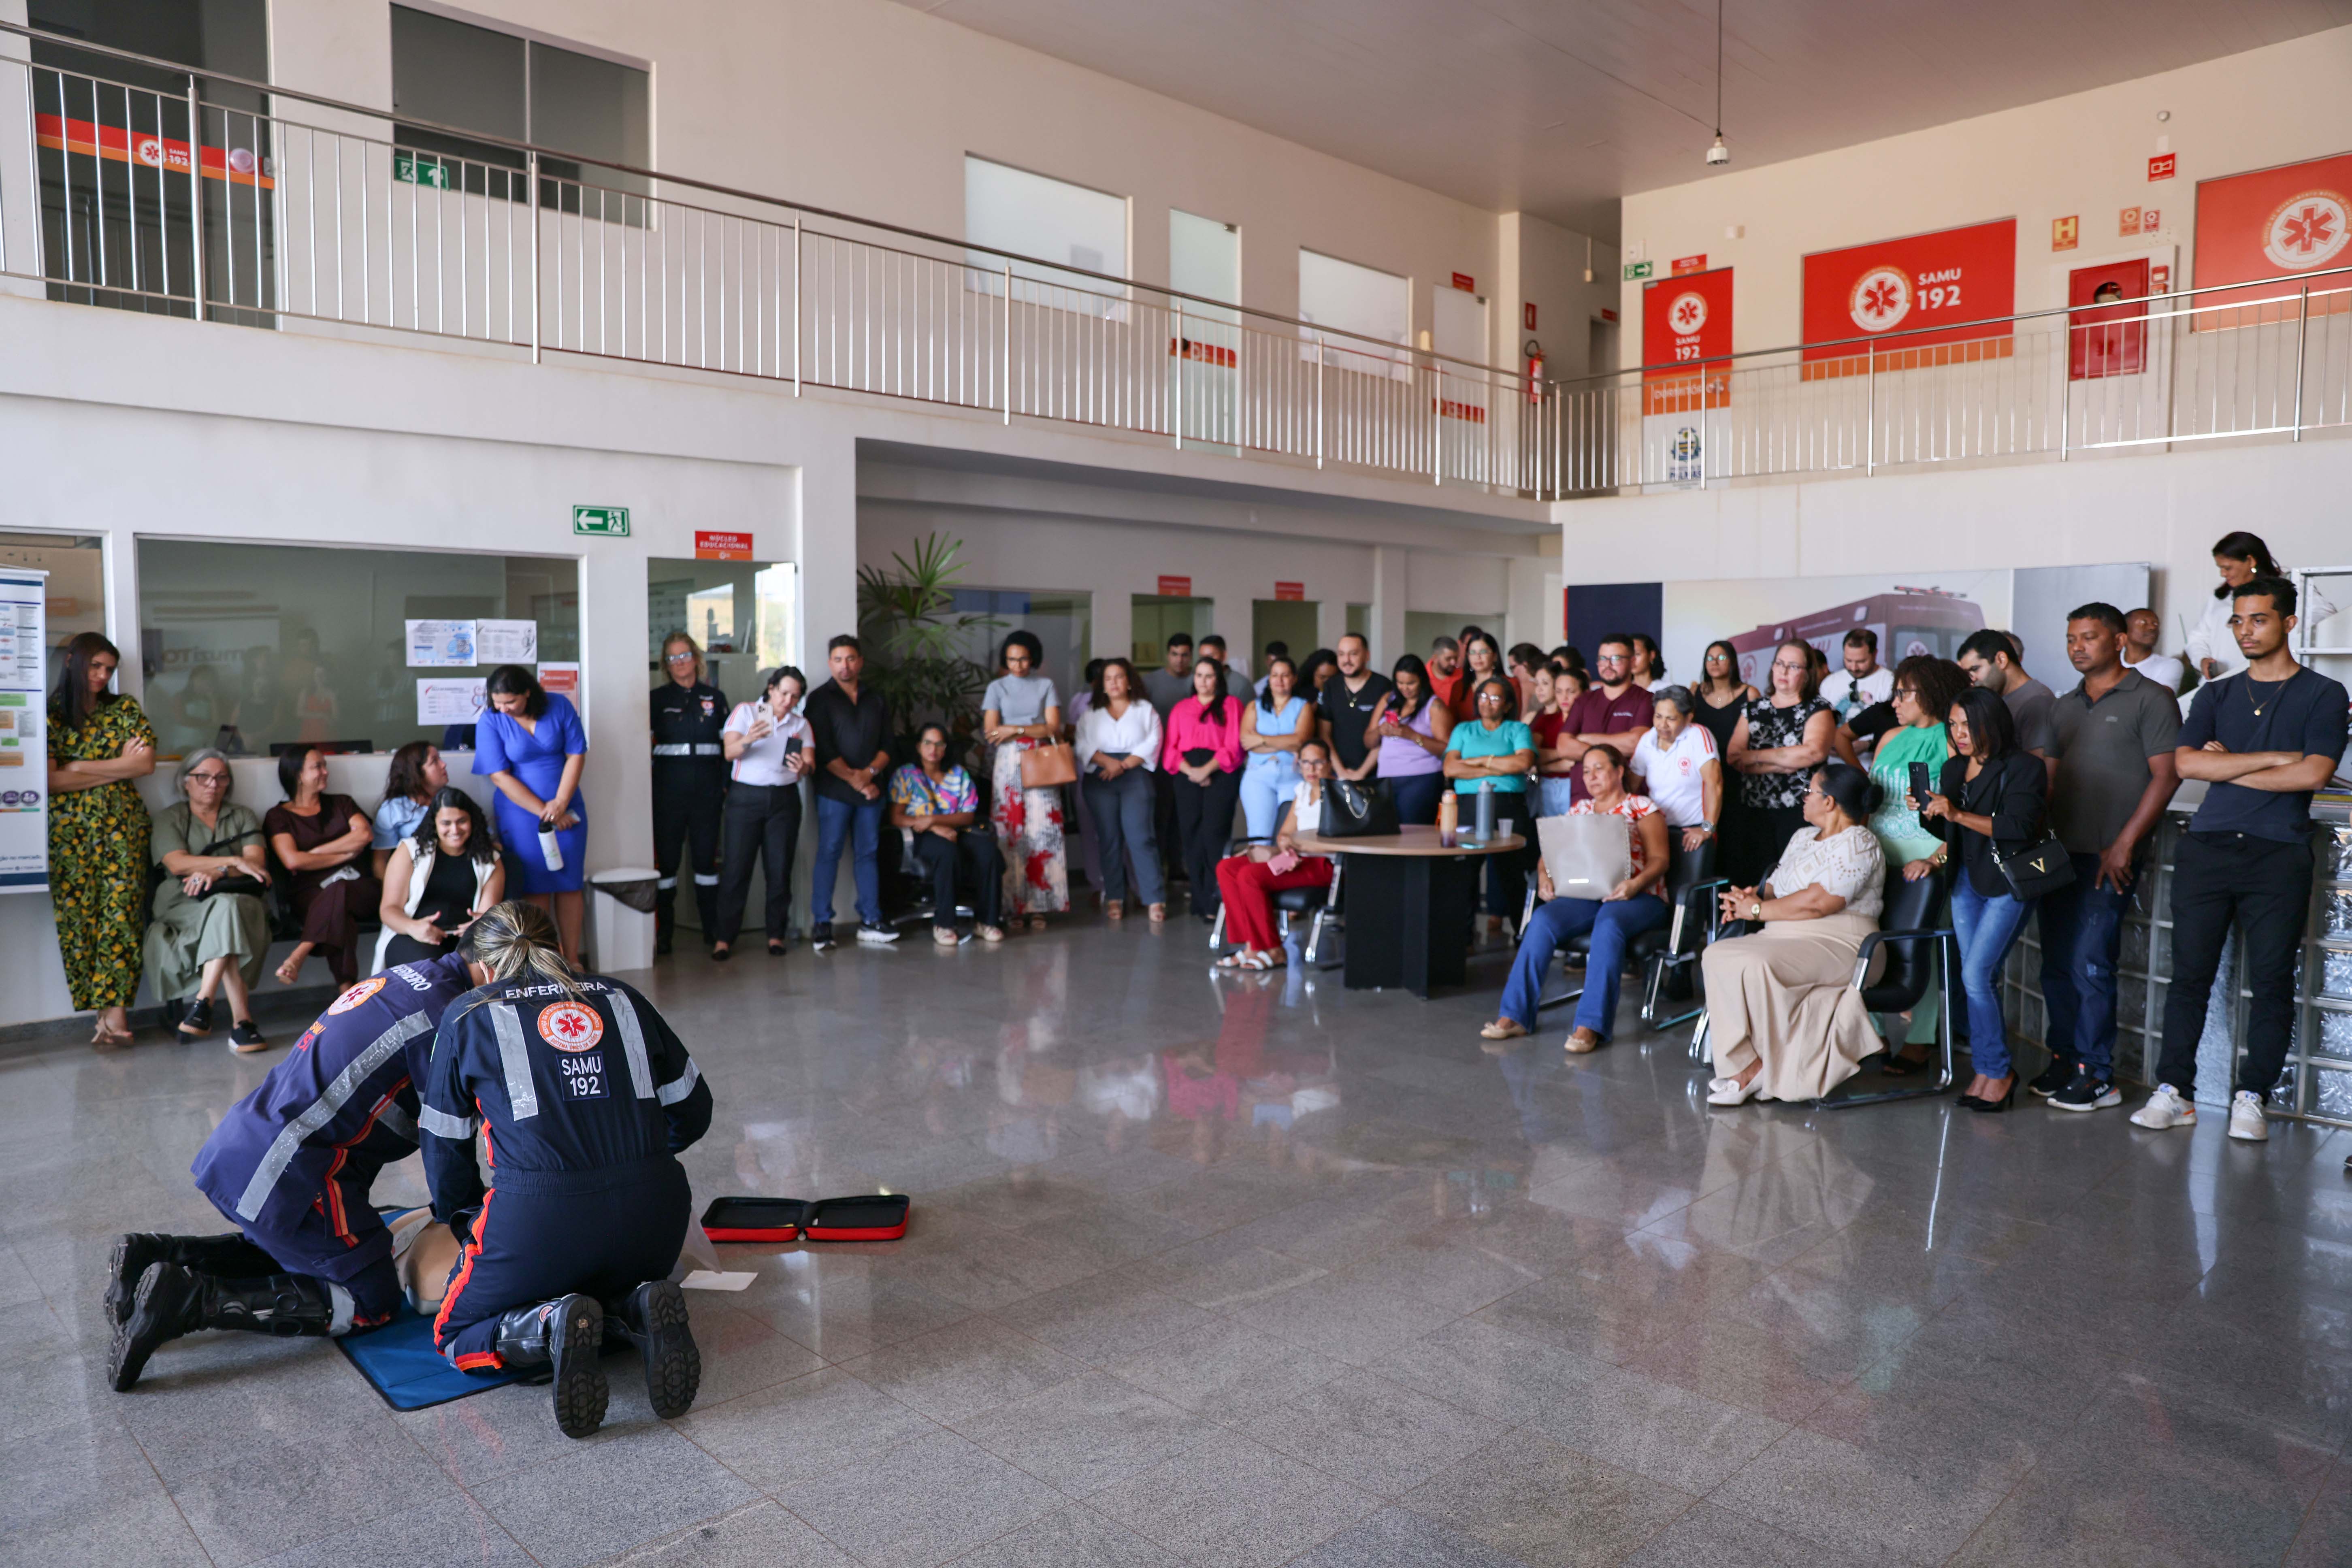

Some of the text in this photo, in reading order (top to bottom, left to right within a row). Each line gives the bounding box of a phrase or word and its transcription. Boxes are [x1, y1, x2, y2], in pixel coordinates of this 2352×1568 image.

[169, 148, 188, 157] SAMU
[169, 155, 188, 166] 192
[1918, 267, 1962, 286] SAMU
[1917, 285, 1961, 310] 192
[1675, 335, 1700, 346] SAMU
[1675, 345, 1700, 360] 192
[699, 541, 748, 550] EDUCACIONAL
[709, 535, 737, 543] NÚCLEO
[2029, 857, 2045, 873] V
[505, 982, 608, 999] ENFERMEIRA
[551, 1038, 568, 1049] SISTEMA
[561, 1056, 602, 1076] SAMU
[570, 1076, 601, 1096] 192
